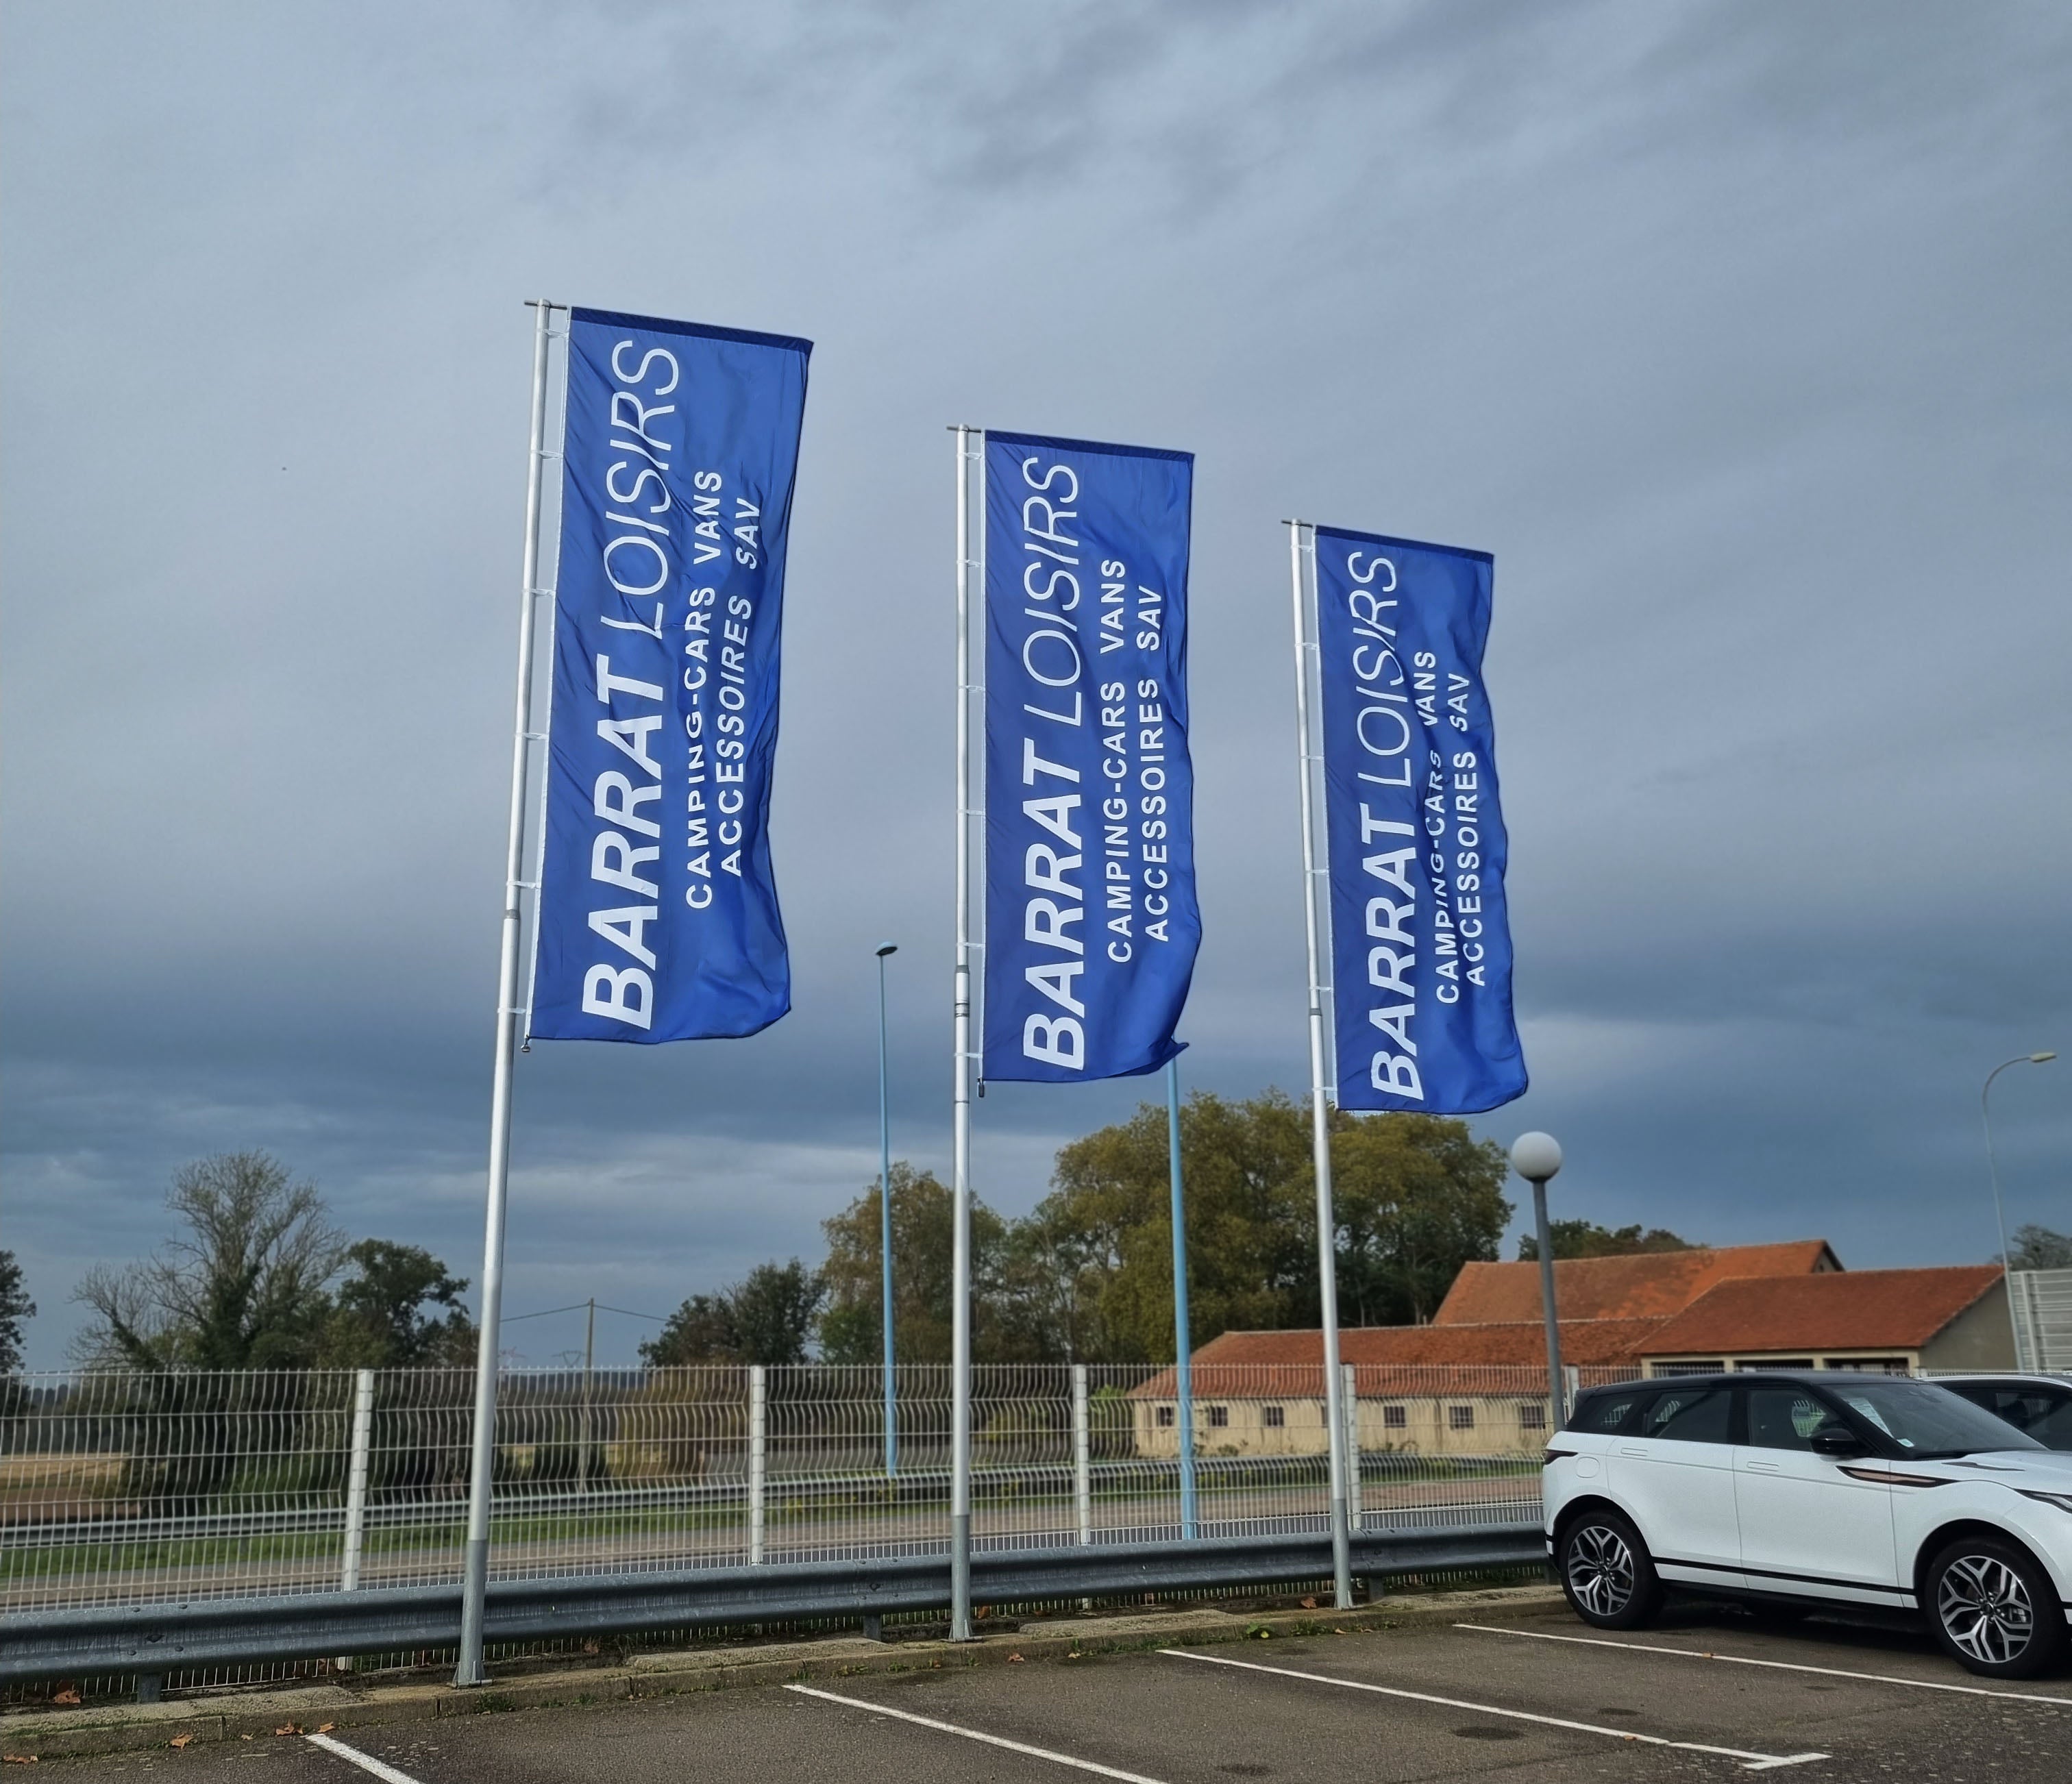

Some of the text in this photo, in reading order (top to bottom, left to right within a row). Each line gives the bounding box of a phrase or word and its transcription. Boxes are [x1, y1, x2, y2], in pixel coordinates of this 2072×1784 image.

[582, 340, 679, 1030] BARRAT LOISIRS
[685, 471, 722, 909] CAMPING-CARS VANS
[716, 497, 760, 877] ACCESSOIRES SAV
[1022, 457, 1084, 1070] BARRAT LOISIRS
[1100, 559, 1132, 963] CAMPING-CARS VANS
[1137, 585, 1168, 942] ACCESSOIRES SAV
[1348, 552, 1424, 1100] BARRAT LOISIRS
[1414, 652, 1459, 1004] CAMPING-CARS VANS
[1448, 673, 1485, 987] ACCESSOIRES SAV
